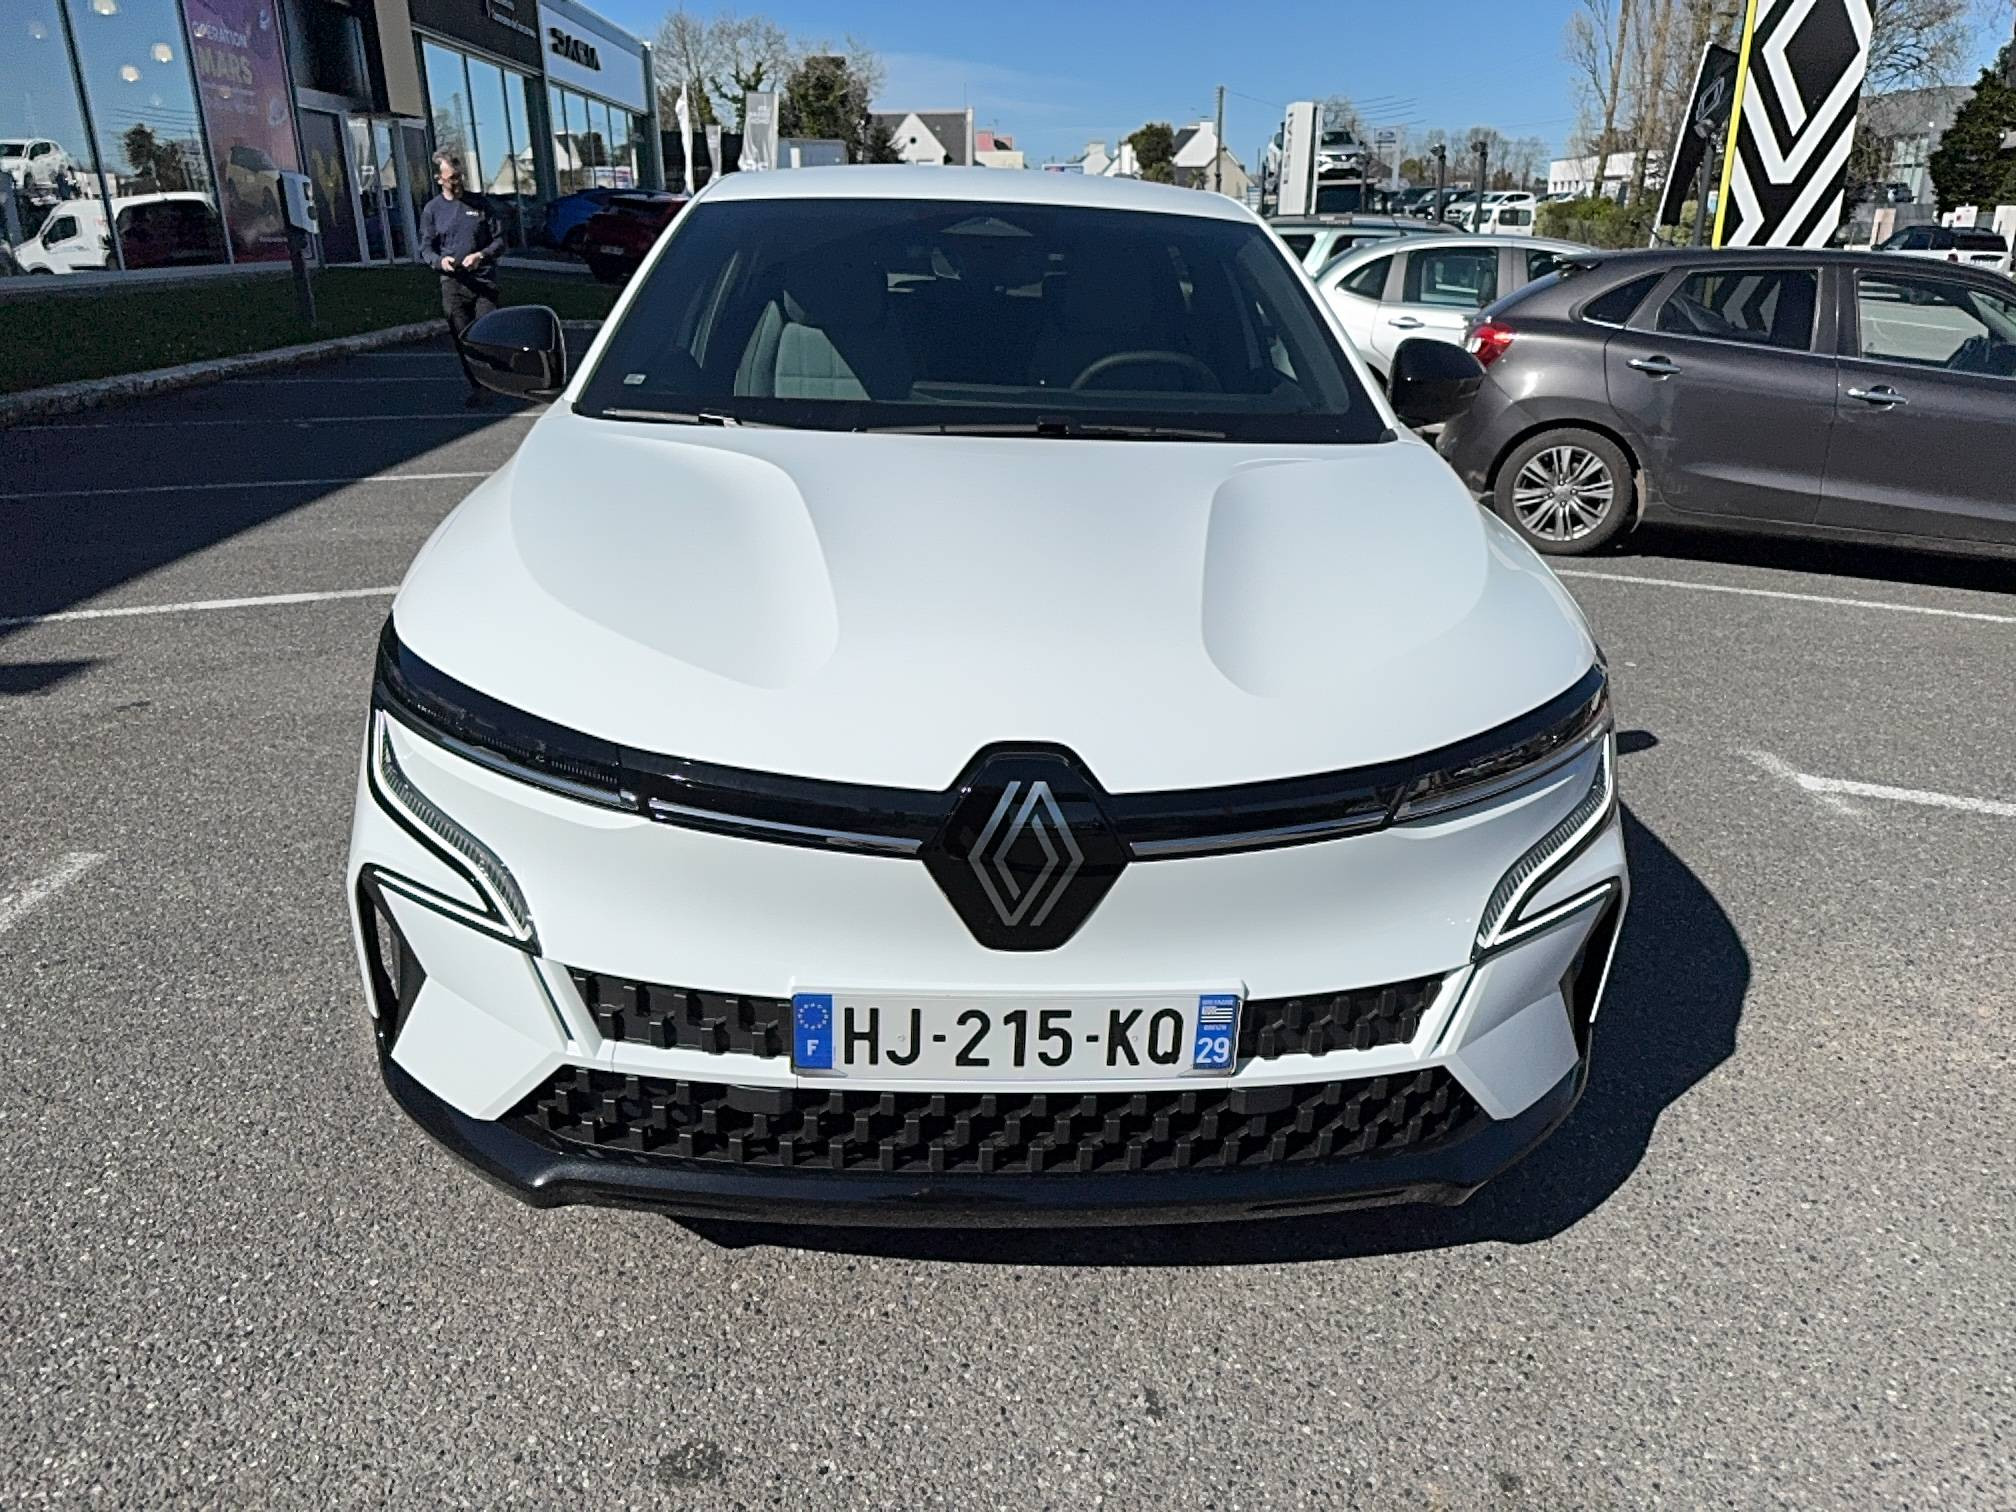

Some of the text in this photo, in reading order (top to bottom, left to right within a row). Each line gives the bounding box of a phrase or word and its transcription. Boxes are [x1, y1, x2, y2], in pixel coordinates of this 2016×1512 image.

[198, 47, 253, 85] MARS
[807, 1040, 818, 1057] F
[843, 1006, 1185, 1067] HJ-215-KQ
[1196, 1037, 1230, 1064] 29
